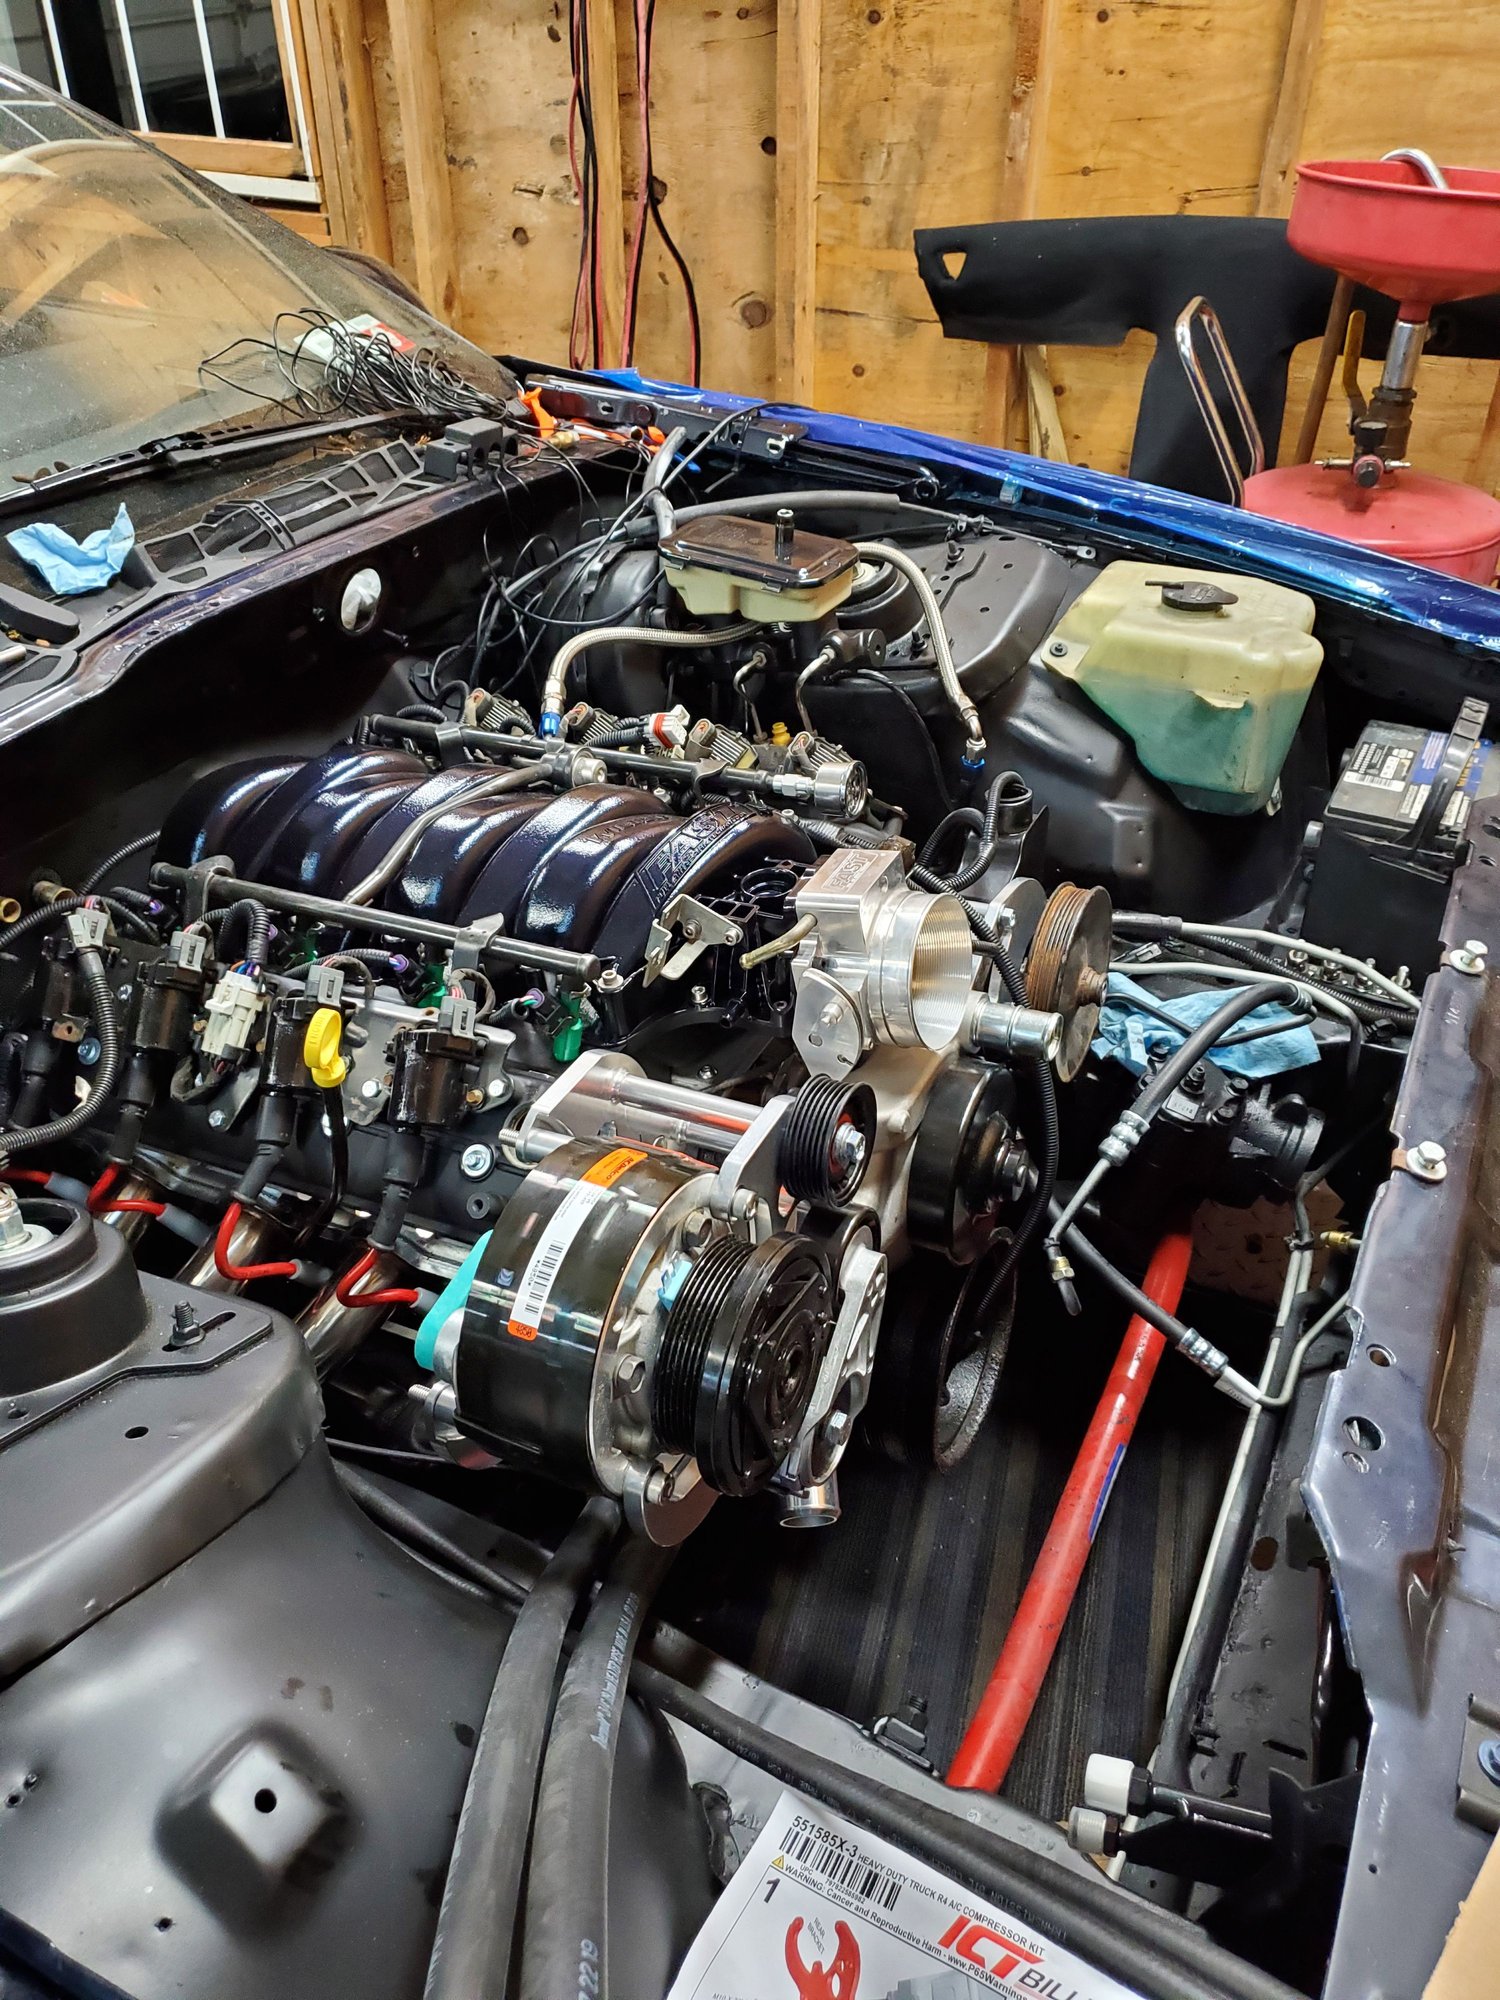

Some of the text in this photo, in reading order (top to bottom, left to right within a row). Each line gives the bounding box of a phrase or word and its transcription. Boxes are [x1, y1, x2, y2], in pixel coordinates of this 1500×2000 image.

[830, 853, 868, 889] FAST
[792, 1815, 1045, 1956] 551585X-3 HEAVY DUTY TRUCK R4 A/C COMPRESSOR KIT
[800, 1865, 814, 1875] UPC
[764, 1878, 780, 1904] 1
[785, 1863, 826, 1893] WARNING:
[827, 1890, 854, 1910] Cancer
[854, 1904, 870, 1917] and
[870, 1911, 921, 1945] Reproductive
[921, 1939, 942, 1957] Harm
[807, 1921, 825, 1955] BRACKET
[813, 1917, 826, 1940] REAR
[580, 1939, 598, 1962] 19
[937, 1914, 1045, 1980] ICT
[579, 1961, 598, 1994] 22
